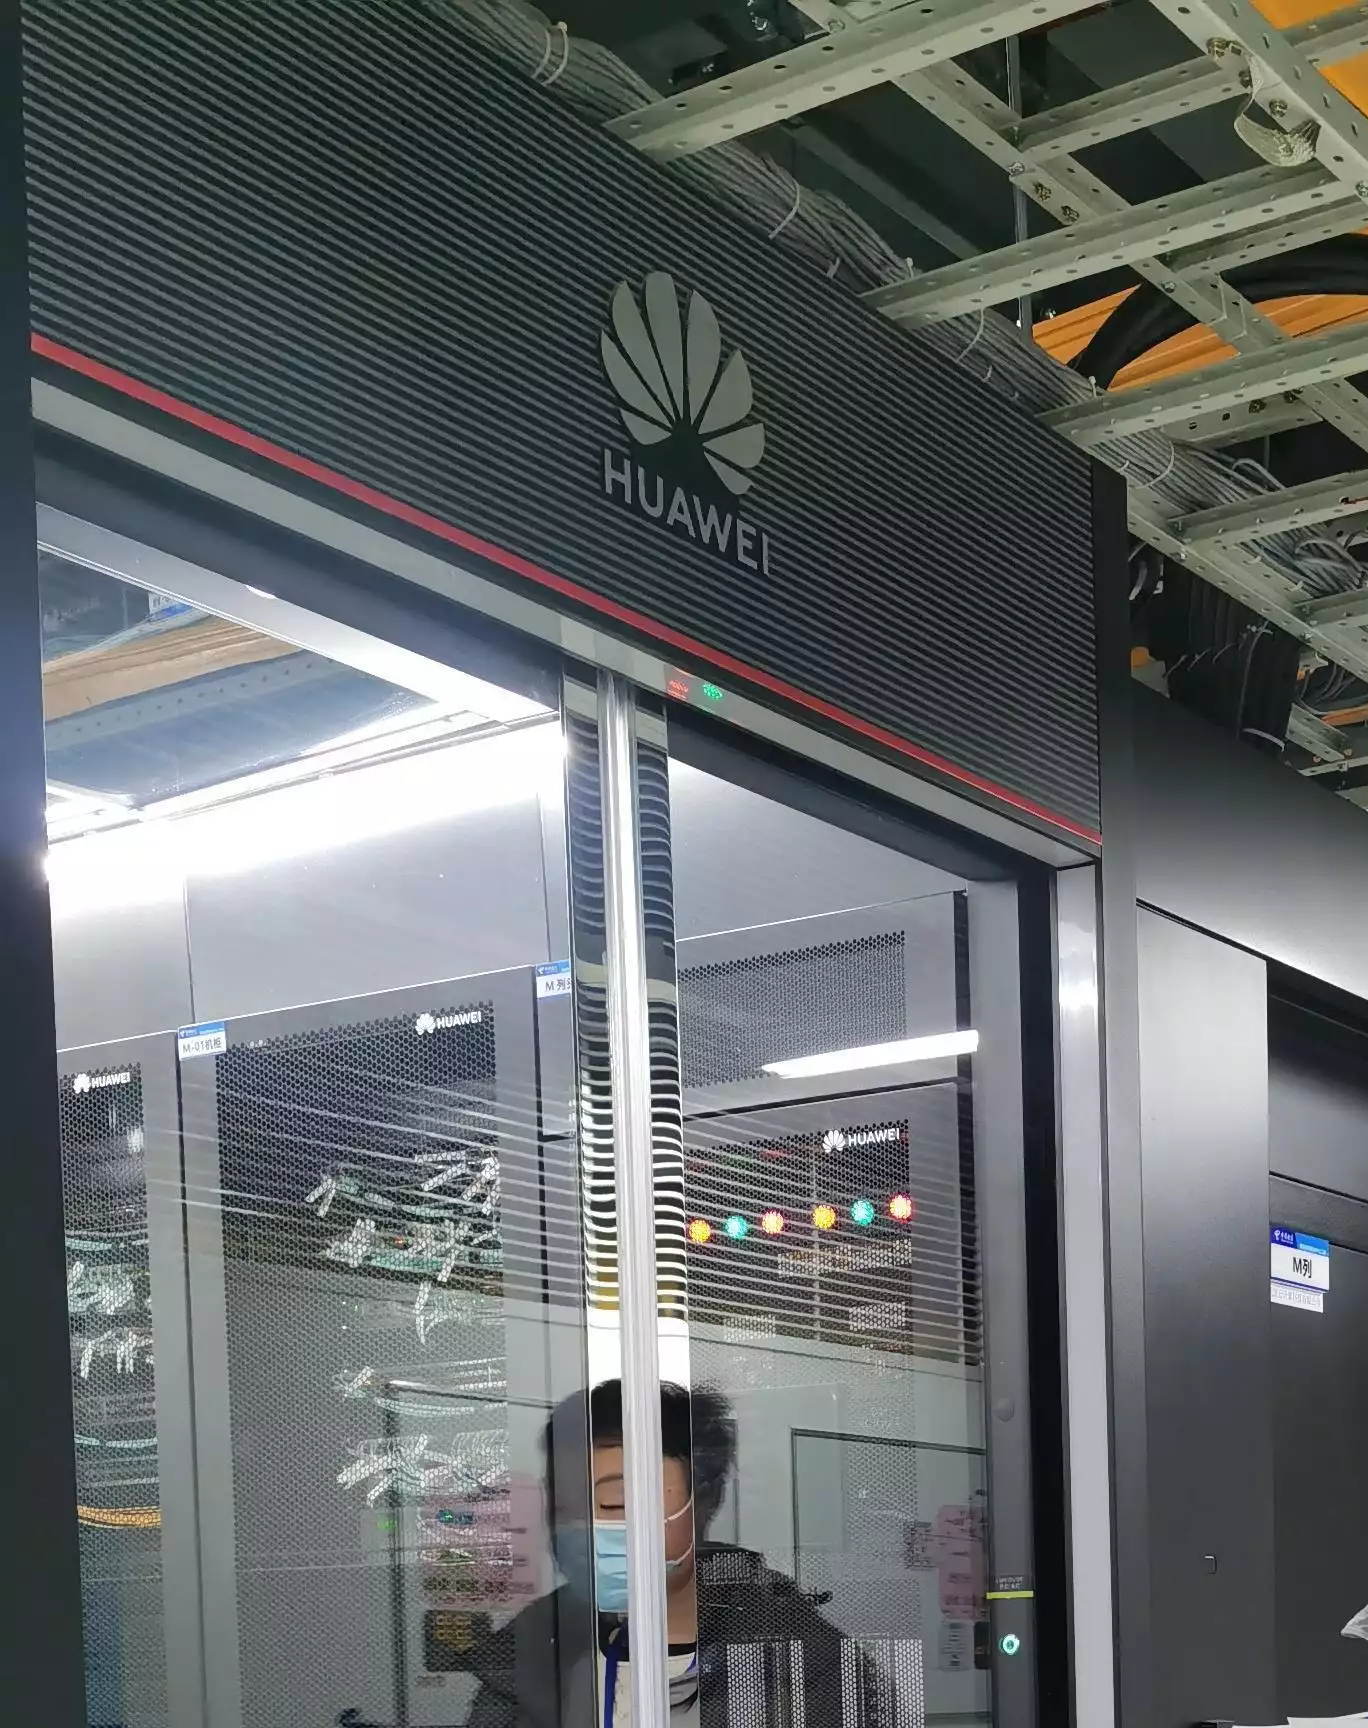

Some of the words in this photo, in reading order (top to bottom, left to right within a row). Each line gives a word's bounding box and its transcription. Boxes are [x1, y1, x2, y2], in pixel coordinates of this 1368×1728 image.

[604, 449, 769, 576] HUAWEI
[436, 1011, 481, 1029] HUAWEI
[91, 1072, 131, 1088] HUAWEI
[848, 1128, 899, 1147] HUAWEI
[1292, 1256, 1312, 1278] M列
